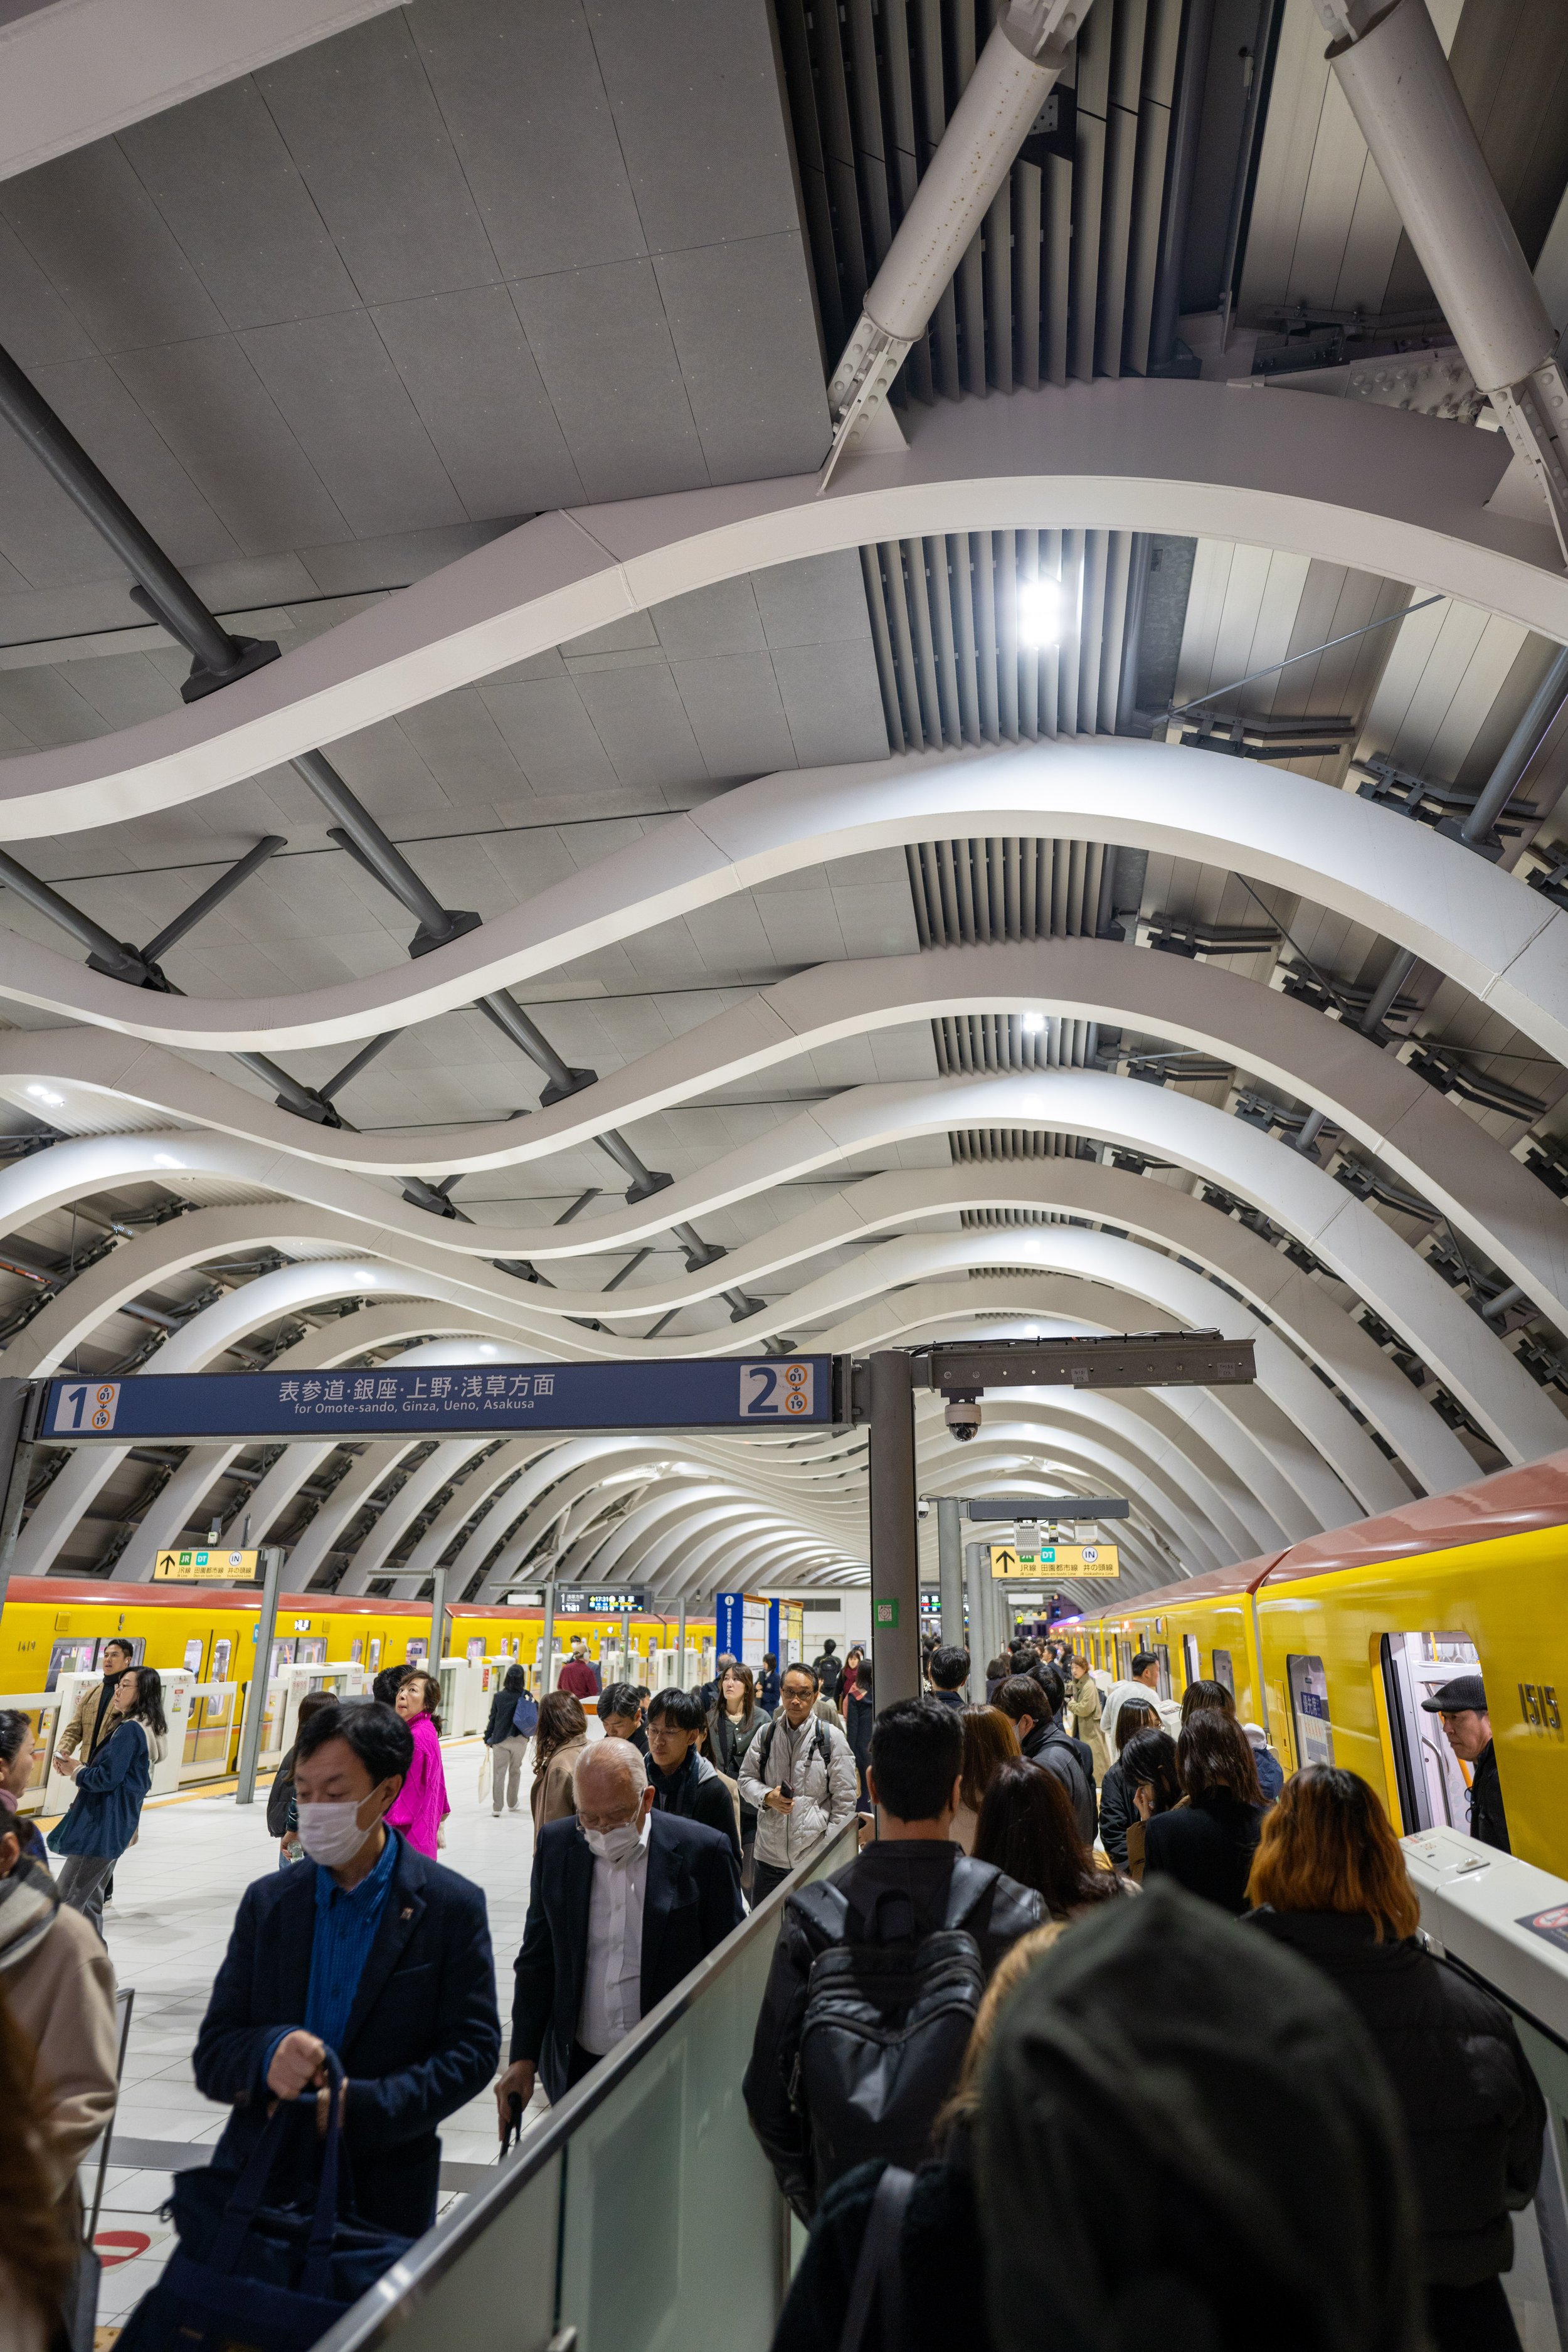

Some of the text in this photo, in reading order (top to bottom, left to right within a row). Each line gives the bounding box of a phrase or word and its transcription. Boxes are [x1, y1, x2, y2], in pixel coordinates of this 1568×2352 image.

[790, 1374, 802, 1382] 01
[748, 1367, 778, 1414] 2
[100, 1392, 110, 1401] 01
[68, 1387, 88, 1428] 1
[294, 1399, 534, 1414] for Omote-sando, Ginza, Ueno, Asakusa
[791, 1401, 803, 1409] 19
[96, 1417, 107, 1425] 19
[181, 1555, 190, 1563] JR
[561, 1593, 565, 1603] 1
[1518, 1682, 1560, 1729] 1515
